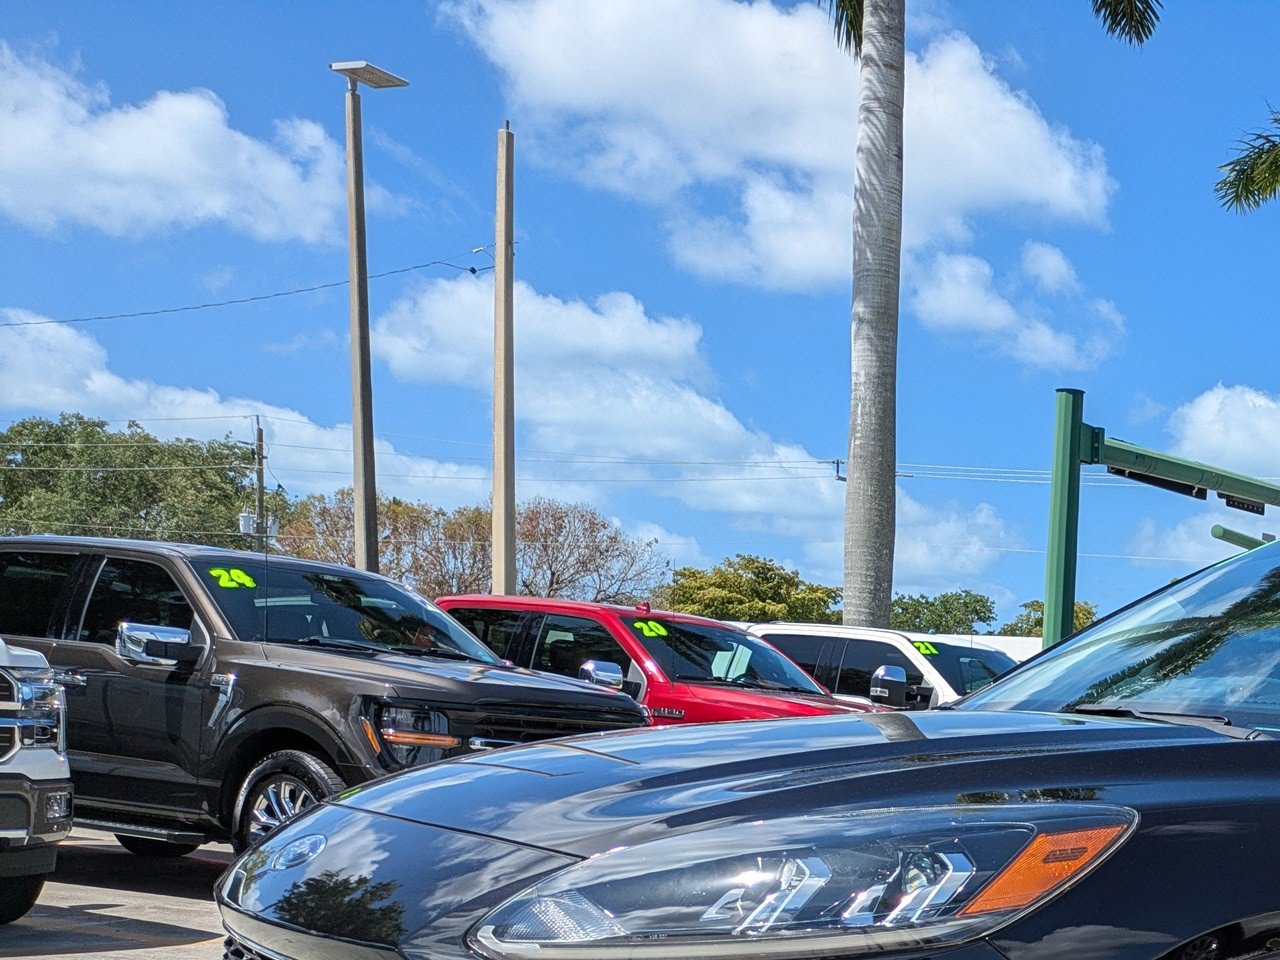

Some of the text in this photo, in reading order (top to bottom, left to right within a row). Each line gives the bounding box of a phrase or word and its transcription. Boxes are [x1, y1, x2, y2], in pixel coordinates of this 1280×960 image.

[209, 568, 257, 588] 24
[633, 620, 669, 637] 20
[913, 641, 940, 655] 21
